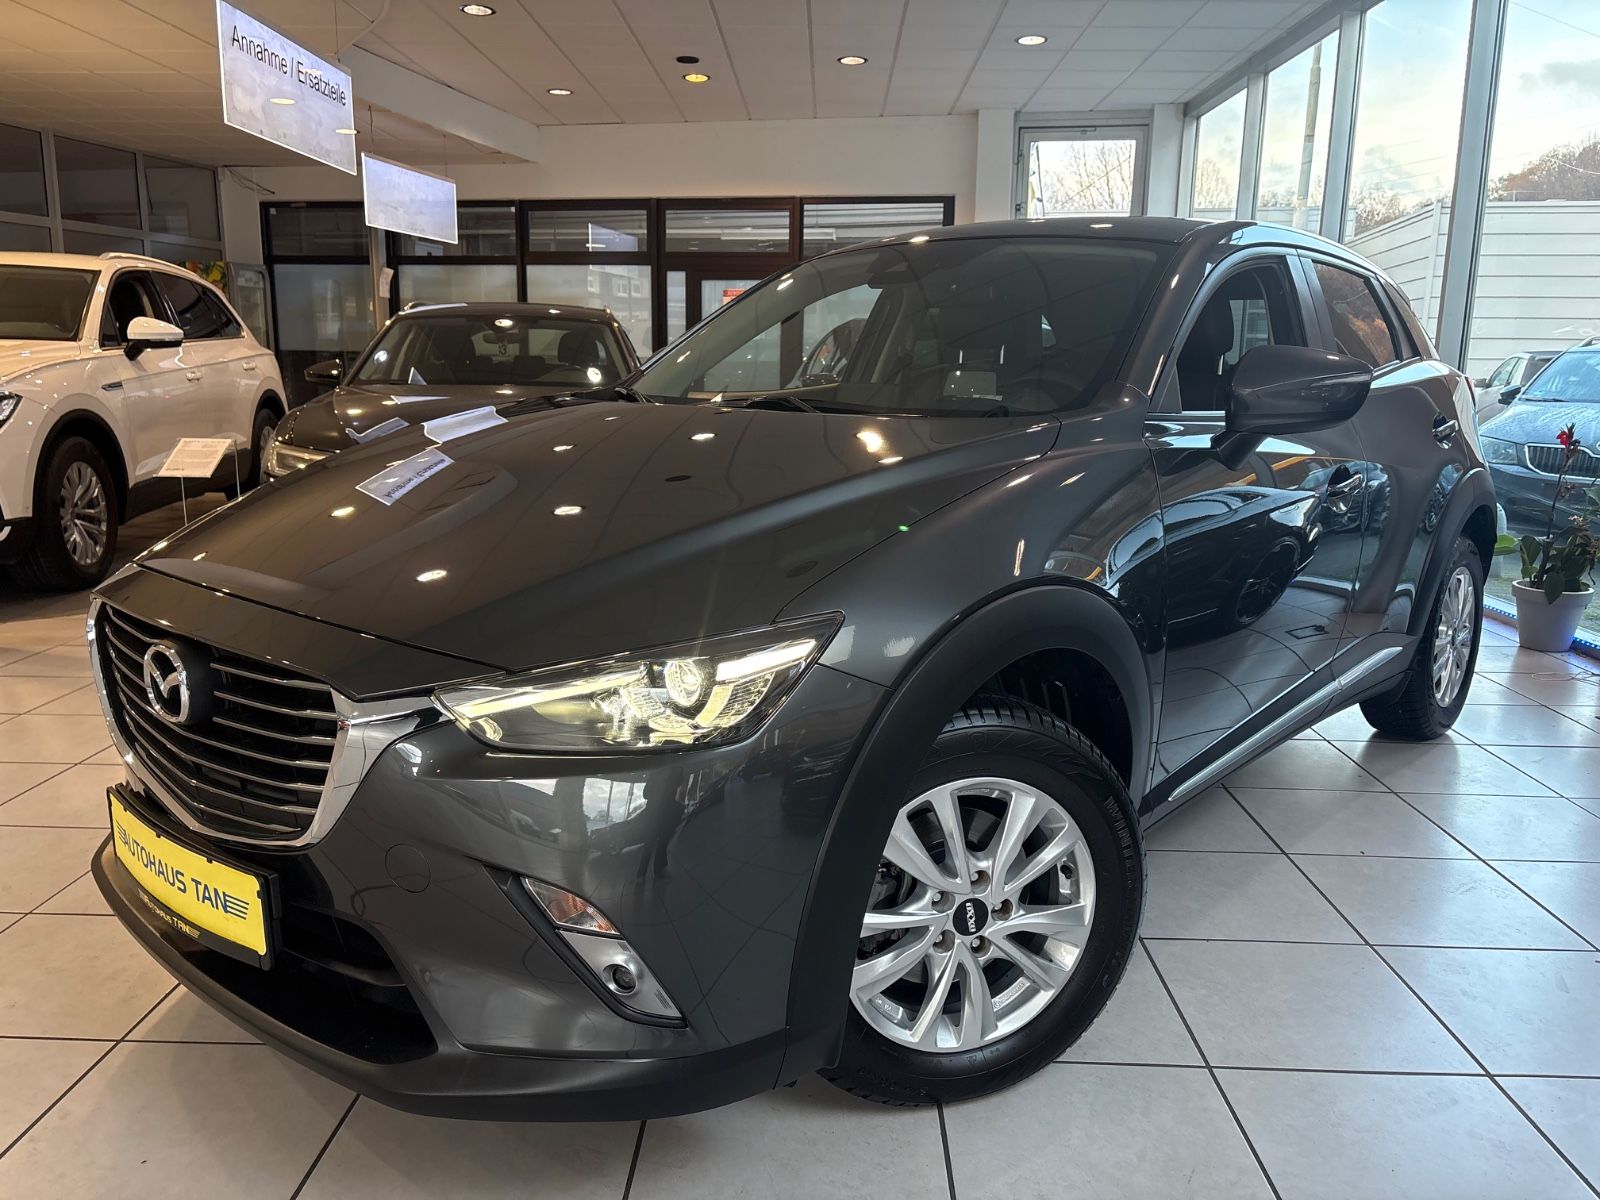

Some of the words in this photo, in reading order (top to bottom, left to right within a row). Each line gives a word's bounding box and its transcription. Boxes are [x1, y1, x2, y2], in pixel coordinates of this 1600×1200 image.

[232, 25, 288, 75] Annahme
[290, 57, 294, 79] /
[297, 61, 346, 107] Ersatzteile
[124, 832, 187, 894] AUTOHAUS
[191, 878, 228, 914] TAN
